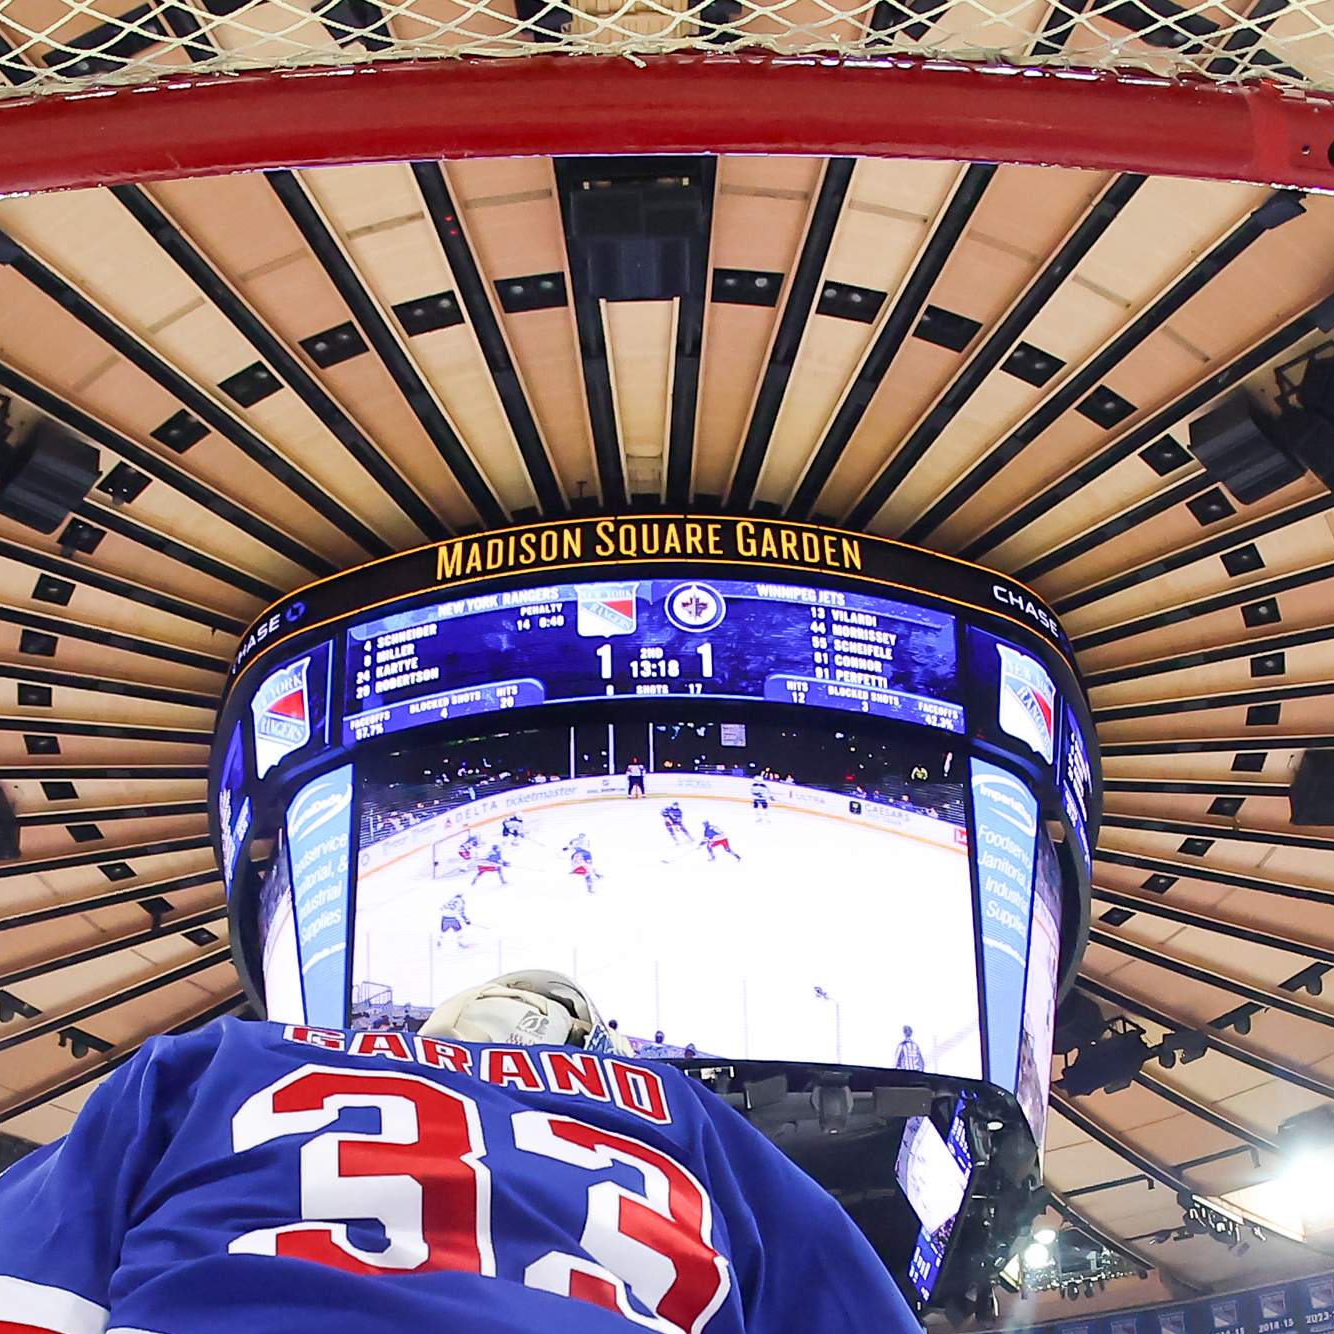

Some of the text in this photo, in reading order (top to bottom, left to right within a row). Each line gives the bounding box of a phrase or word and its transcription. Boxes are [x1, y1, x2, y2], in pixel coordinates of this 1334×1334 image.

[436, 520, 862, 581] MADISON SQUARE GARDEN
[438, 588, 559, 617] NEW YORK RANGERS
[756, 584, 845, 606] WINNIPEG JETS
[520, 603, 563, 616] PENALTY
[810, 606, 878, 628] 13 VILARDI
[992, 585, 1059, 637] CHASE
[517, 620, 531, 631] 14
[809, 621, 897, 647] 44 MORRISSEY
[364, 624, 438, 652] 4 SCHNEIDER
[376, 643, 415, 663] MILLER
[596, 641, 713, 679] 1 13:18 1
[639, 647, 664, 660] 2ND
[833, 639, 893, 661] SCHEIFELE
[375, 657, 419, 679] KARTYE
[834, 654, 883, 673] CONNOR
[375, 667, 439, 694] ROBERTSON
[635, 684, 669, 695] SHOTS
[687, 683, 703, 695] 17
[786, 680, 809, 692] HITS
[835, 668, 888, 689] PERFETTI
[496, 685, 518, 697] HITS
[791, 692, 806, 704] 12
[827, 685, 900, 706] BLOCKED SHOTS
[409, 690, 481, 714] BLOCKED SHOTS
[918, 702, 959, 719] FACEOFFS
[349, 710, 391, 730] FACEOFFS
[440, 707, 448, 719] 4
[283, 1024, 672, 1125] GARAND
